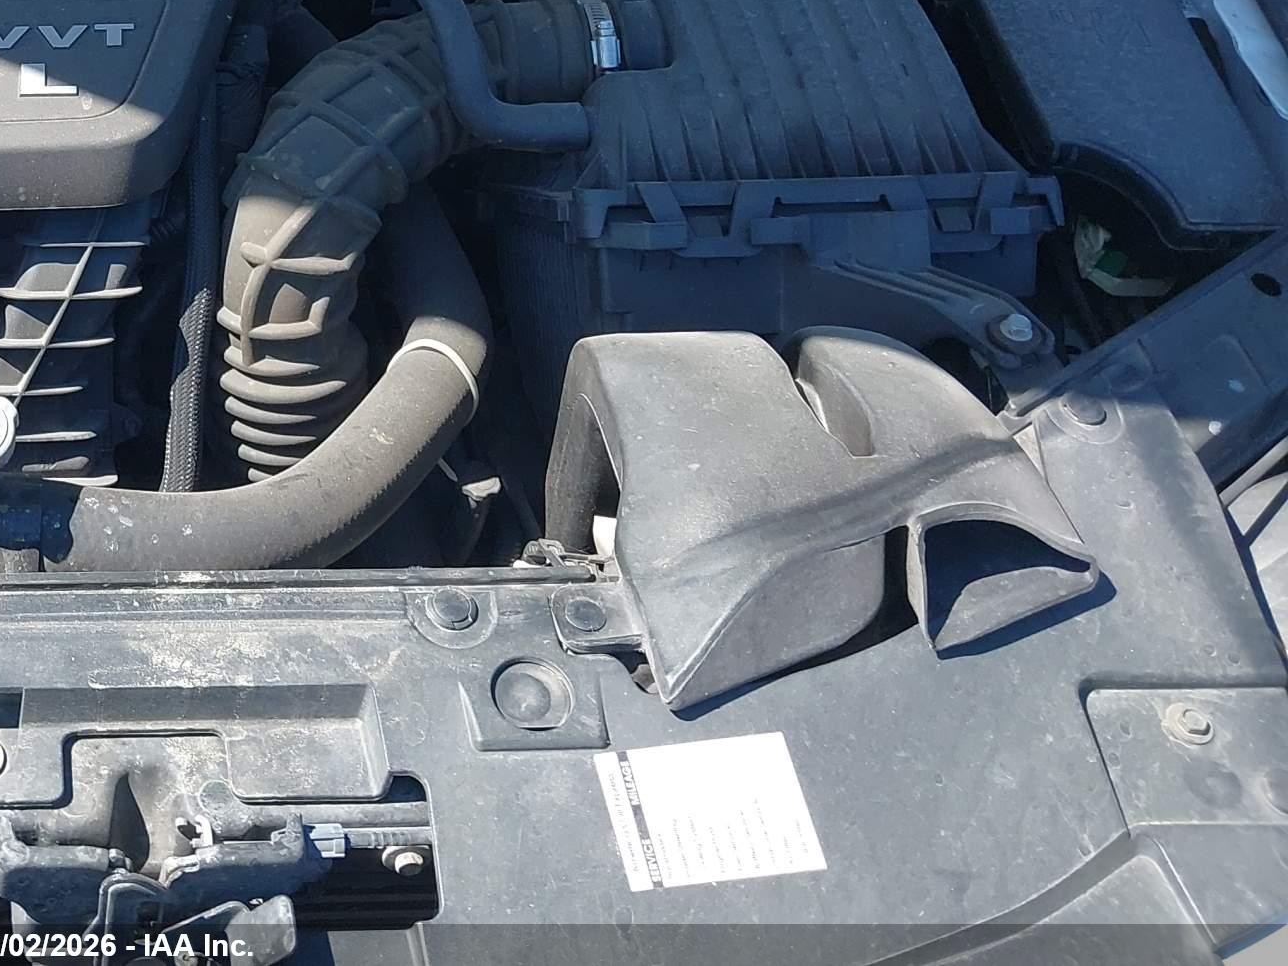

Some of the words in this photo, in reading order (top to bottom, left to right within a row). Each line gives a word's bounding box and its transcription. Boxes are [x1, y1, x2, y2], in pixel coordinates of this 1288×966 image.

[19, 63, 79, 97] L
[619, 760, 641, 806] MILEAGE
[640, 838, 662, 883] SERVICE
